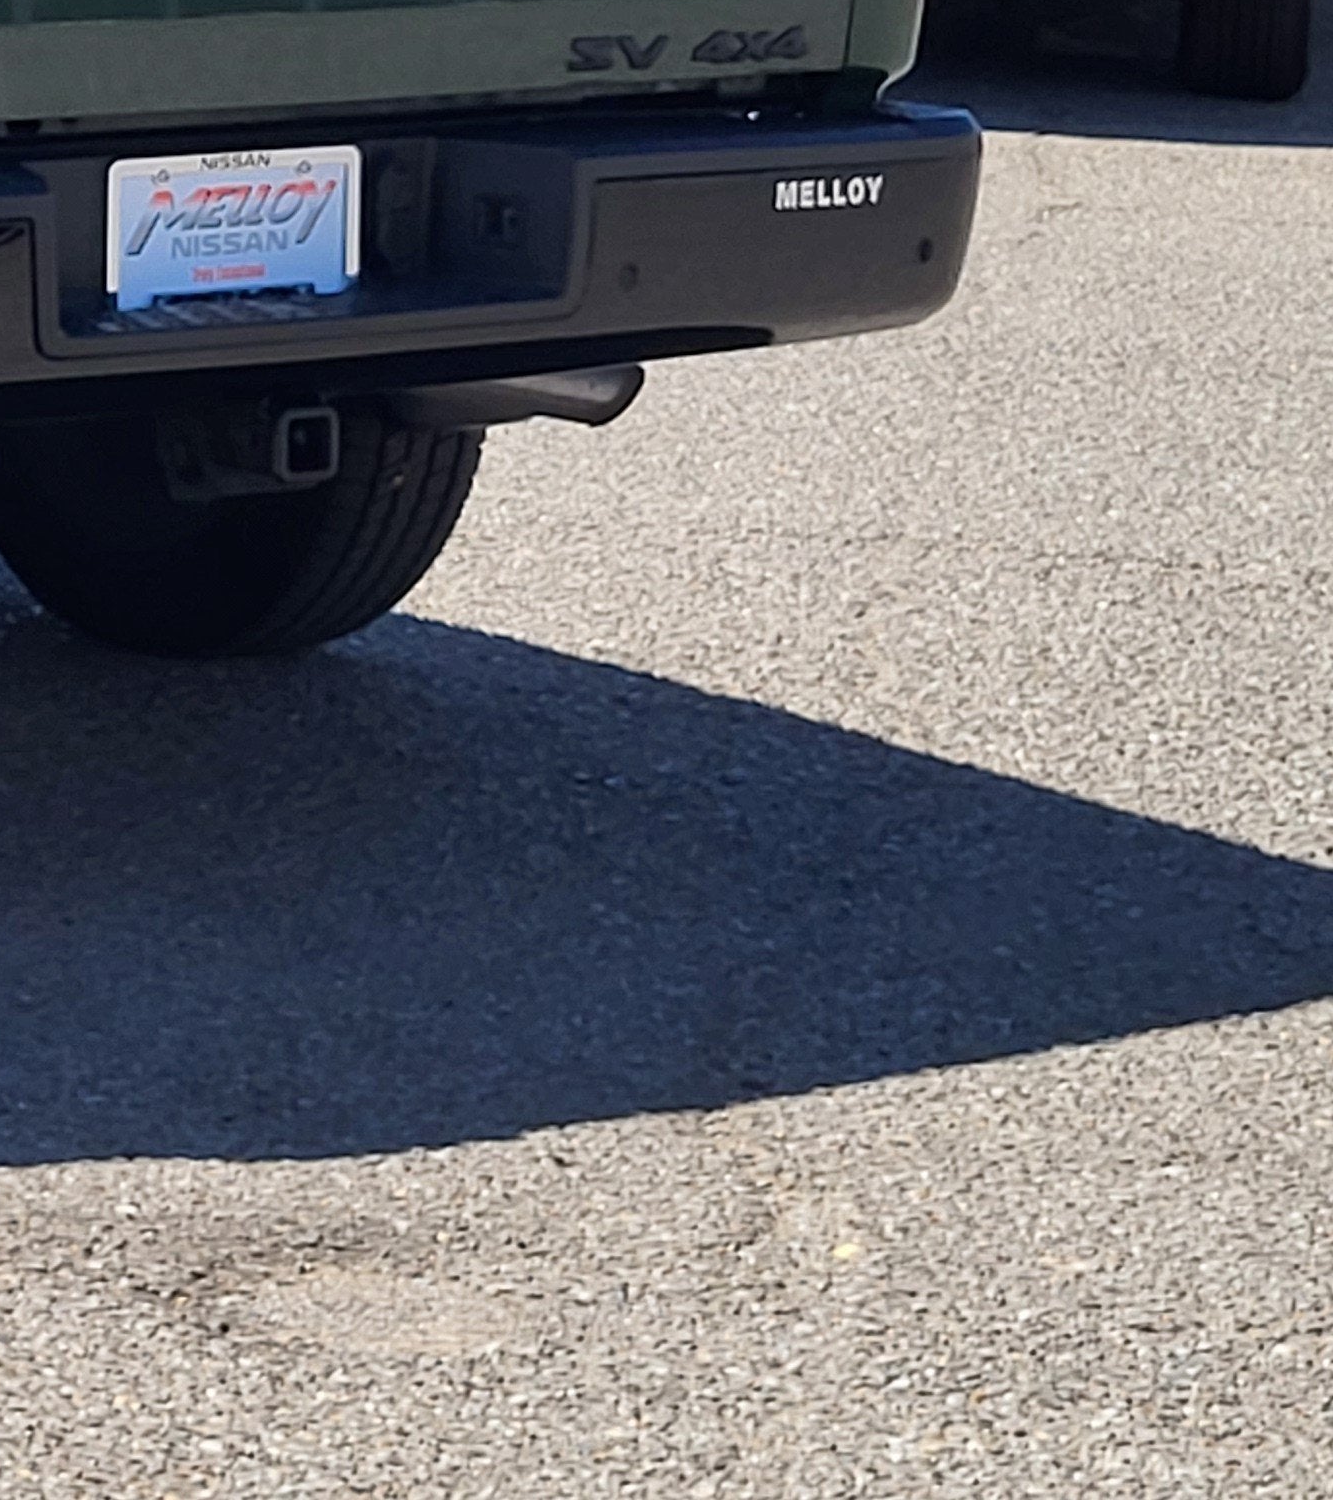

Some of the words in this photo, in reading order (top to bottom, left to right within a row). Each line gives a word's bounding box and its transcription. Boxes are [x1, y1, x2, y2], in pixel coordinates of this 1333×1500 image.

[566, 34, 670, 73] SV
[198, 153, 272, 171] NISSAN
[774, 175, 885, 211] MELLOY
[170, 230, 289, 259] NISSAN
